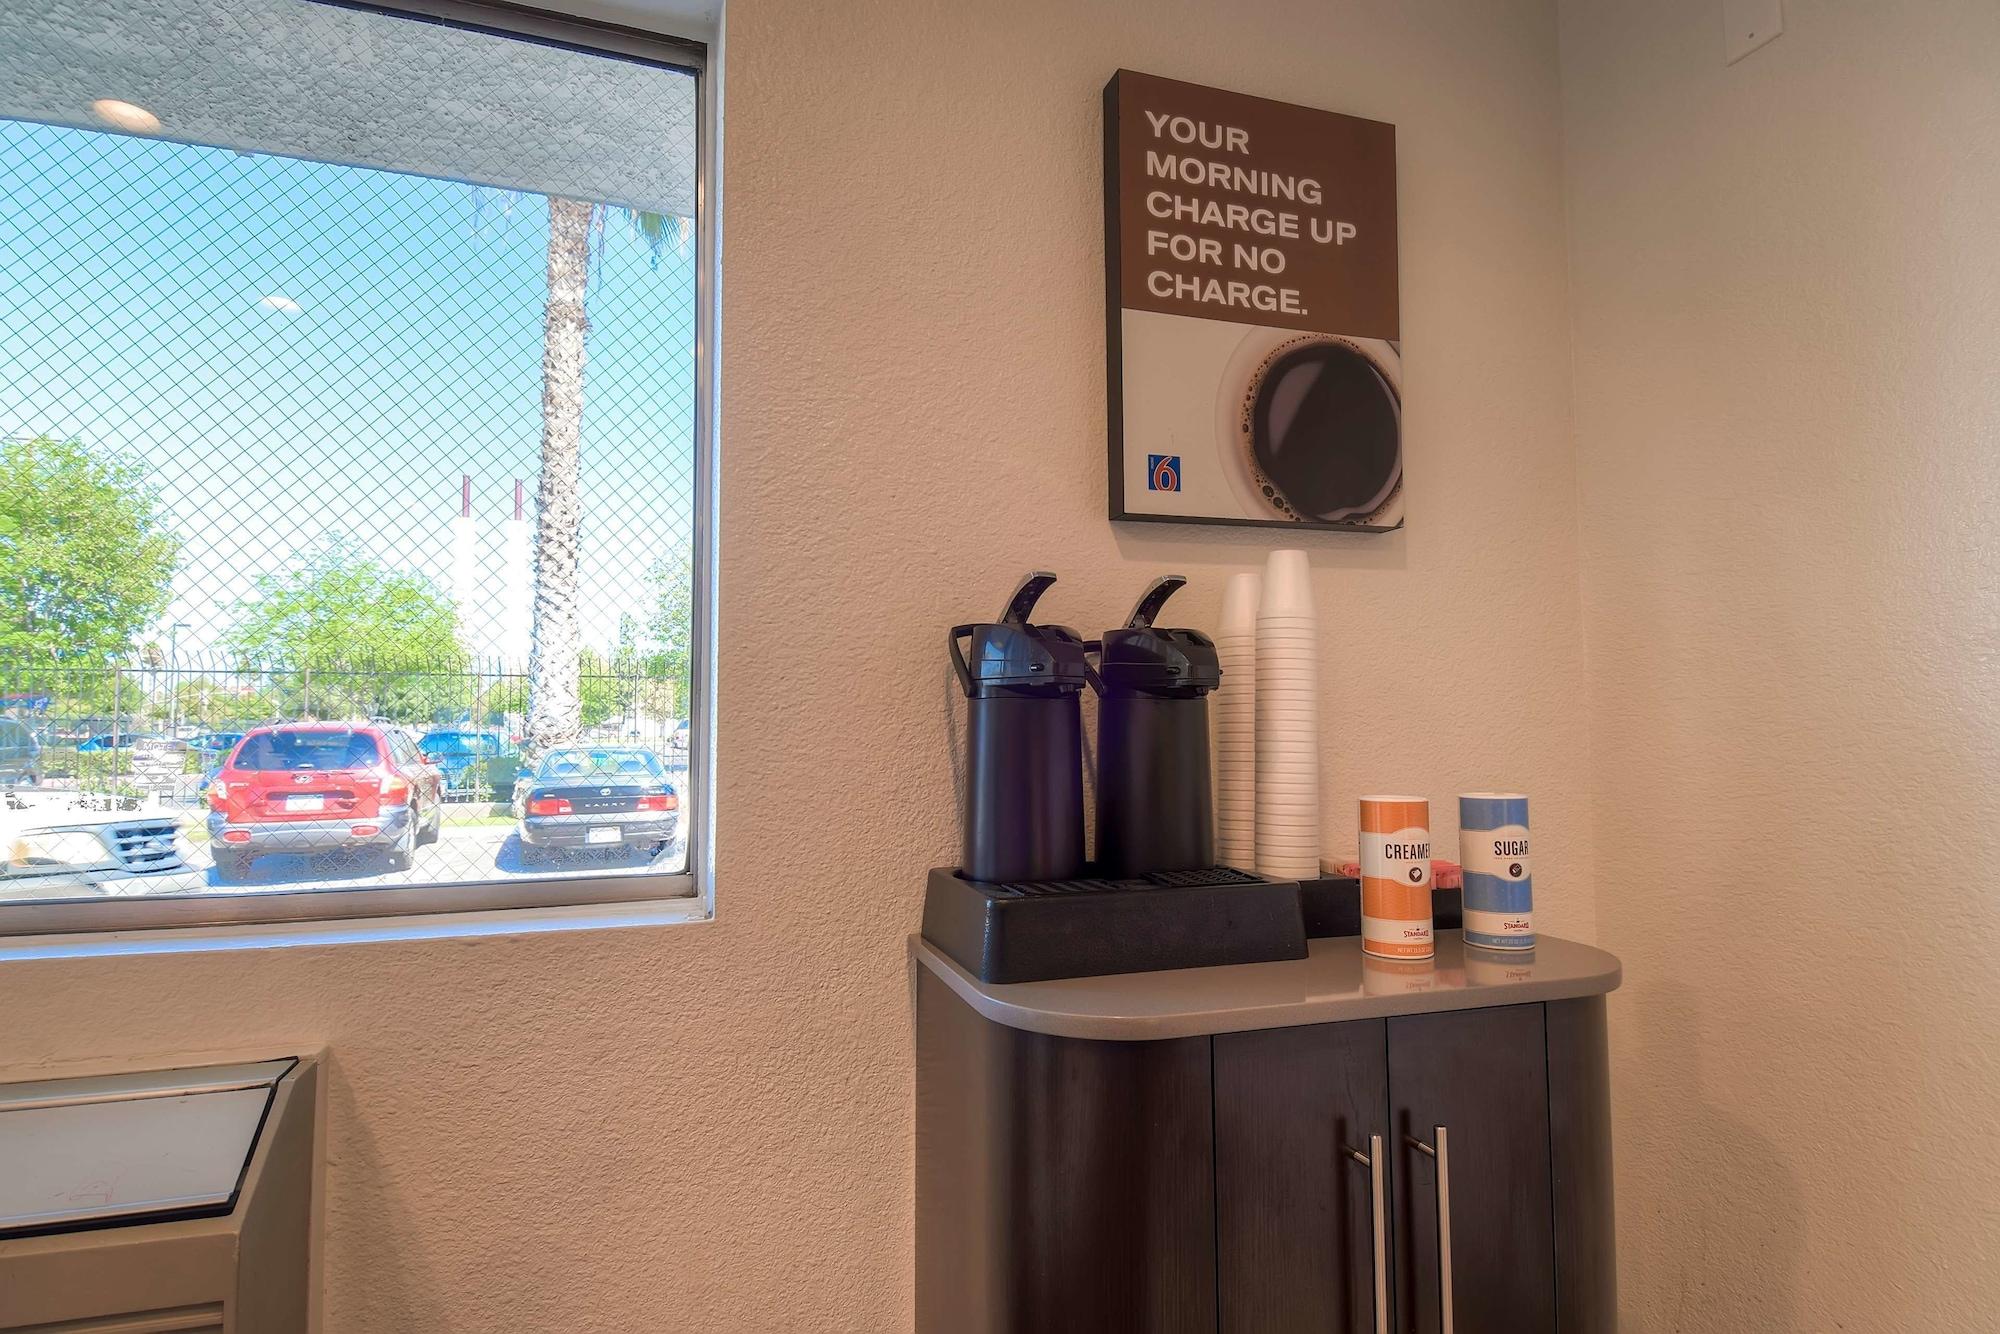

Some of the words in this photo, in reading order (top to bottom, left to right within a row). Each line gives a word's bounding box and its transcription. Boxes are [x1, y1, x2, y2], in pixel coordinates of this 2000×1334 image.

[1145, 110, 1249, 155] YOUR
[1147, 150, 1322, 205] MORNING
[1146, 191, 1299, 239] CHARGE
[1310, 217, 1357, 245] UP
[1148, 230, 1223, 266] FOR
[1234, 244, 1286, 274] NO
[1147, 270, 1308, 315] CHARGE.
[1153, 456, 1178, 492] 6
[1494, 840, 1529, 856] SUGAR
